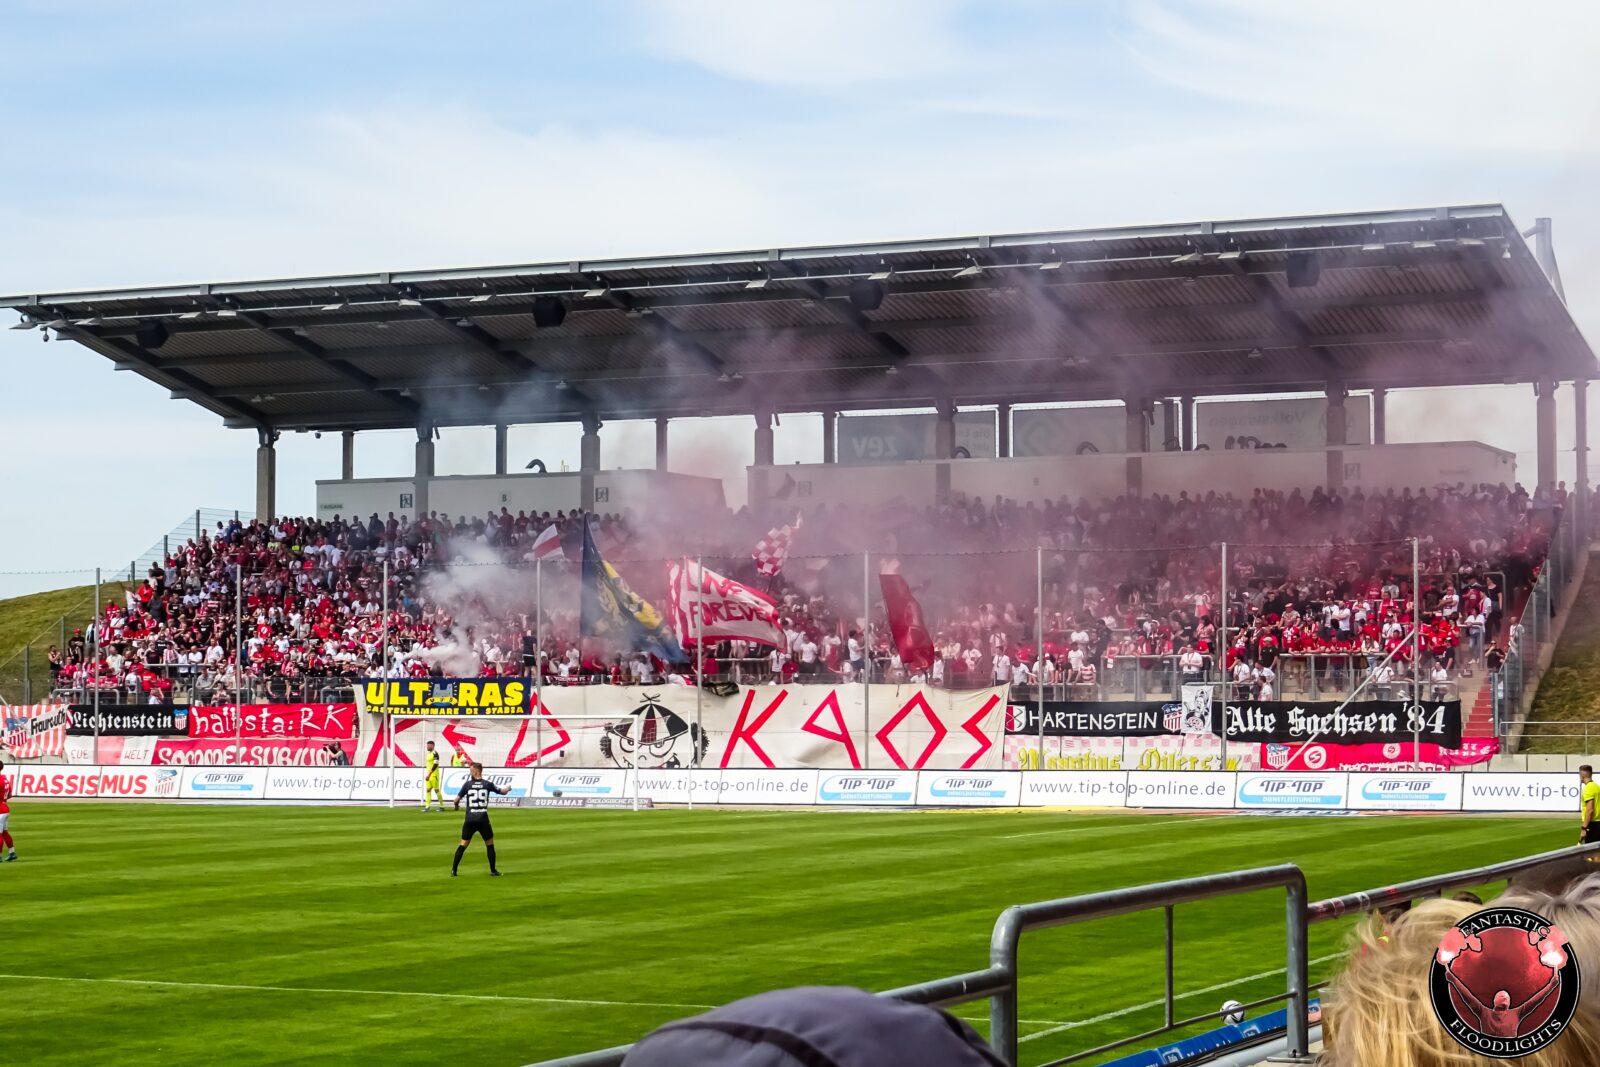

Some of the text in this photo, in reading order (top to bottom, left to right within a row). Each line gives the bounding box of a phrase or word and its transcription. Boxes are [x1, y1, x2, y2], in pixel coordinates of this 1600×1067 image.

[366, 681, 525, 707] ULTRAS
[485, 706, 524, 714] STABIA
[1028, 709, 1158, 731] HARTENSTEIN
[73, 710, 173, 732] Lichtenstein
[719, 688, 1001, 769] KAOS
[1226, 706, 1276, 735] Alte
[1287, 706, 1397, 737] Sachsen
[20, 774, 149, 795] RASSISMUS
[632, 778, 809, 795] www.tip-top-online.de
[1029, 779, 1226, 797] www.tip-top-online.de
[1472, 783, 1579, 801] www.tip-to
[467, 789, 489, 807] 29
